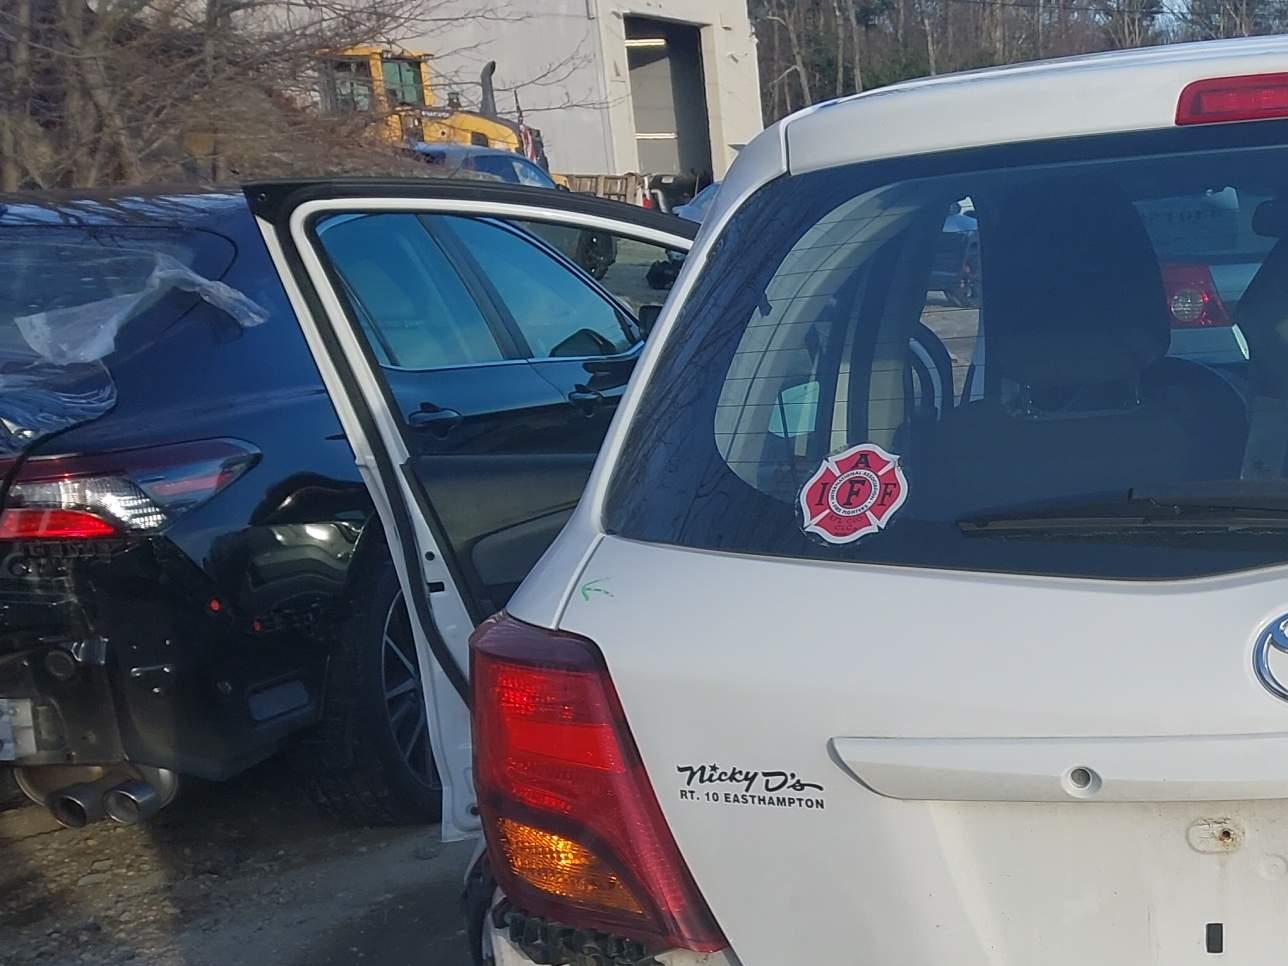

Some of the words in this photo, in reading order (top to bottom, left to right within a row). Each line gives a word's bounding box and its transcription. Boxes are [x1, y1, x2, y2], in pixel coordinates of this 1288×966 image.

[676, 763, 759, 793] Nicky
[761, 771, 825, 793] D's
[679, 789, 700, 801] RT.
[704, 790, 720, 802] 10
[723, 792, 825, 810] EASTHAMPTON
